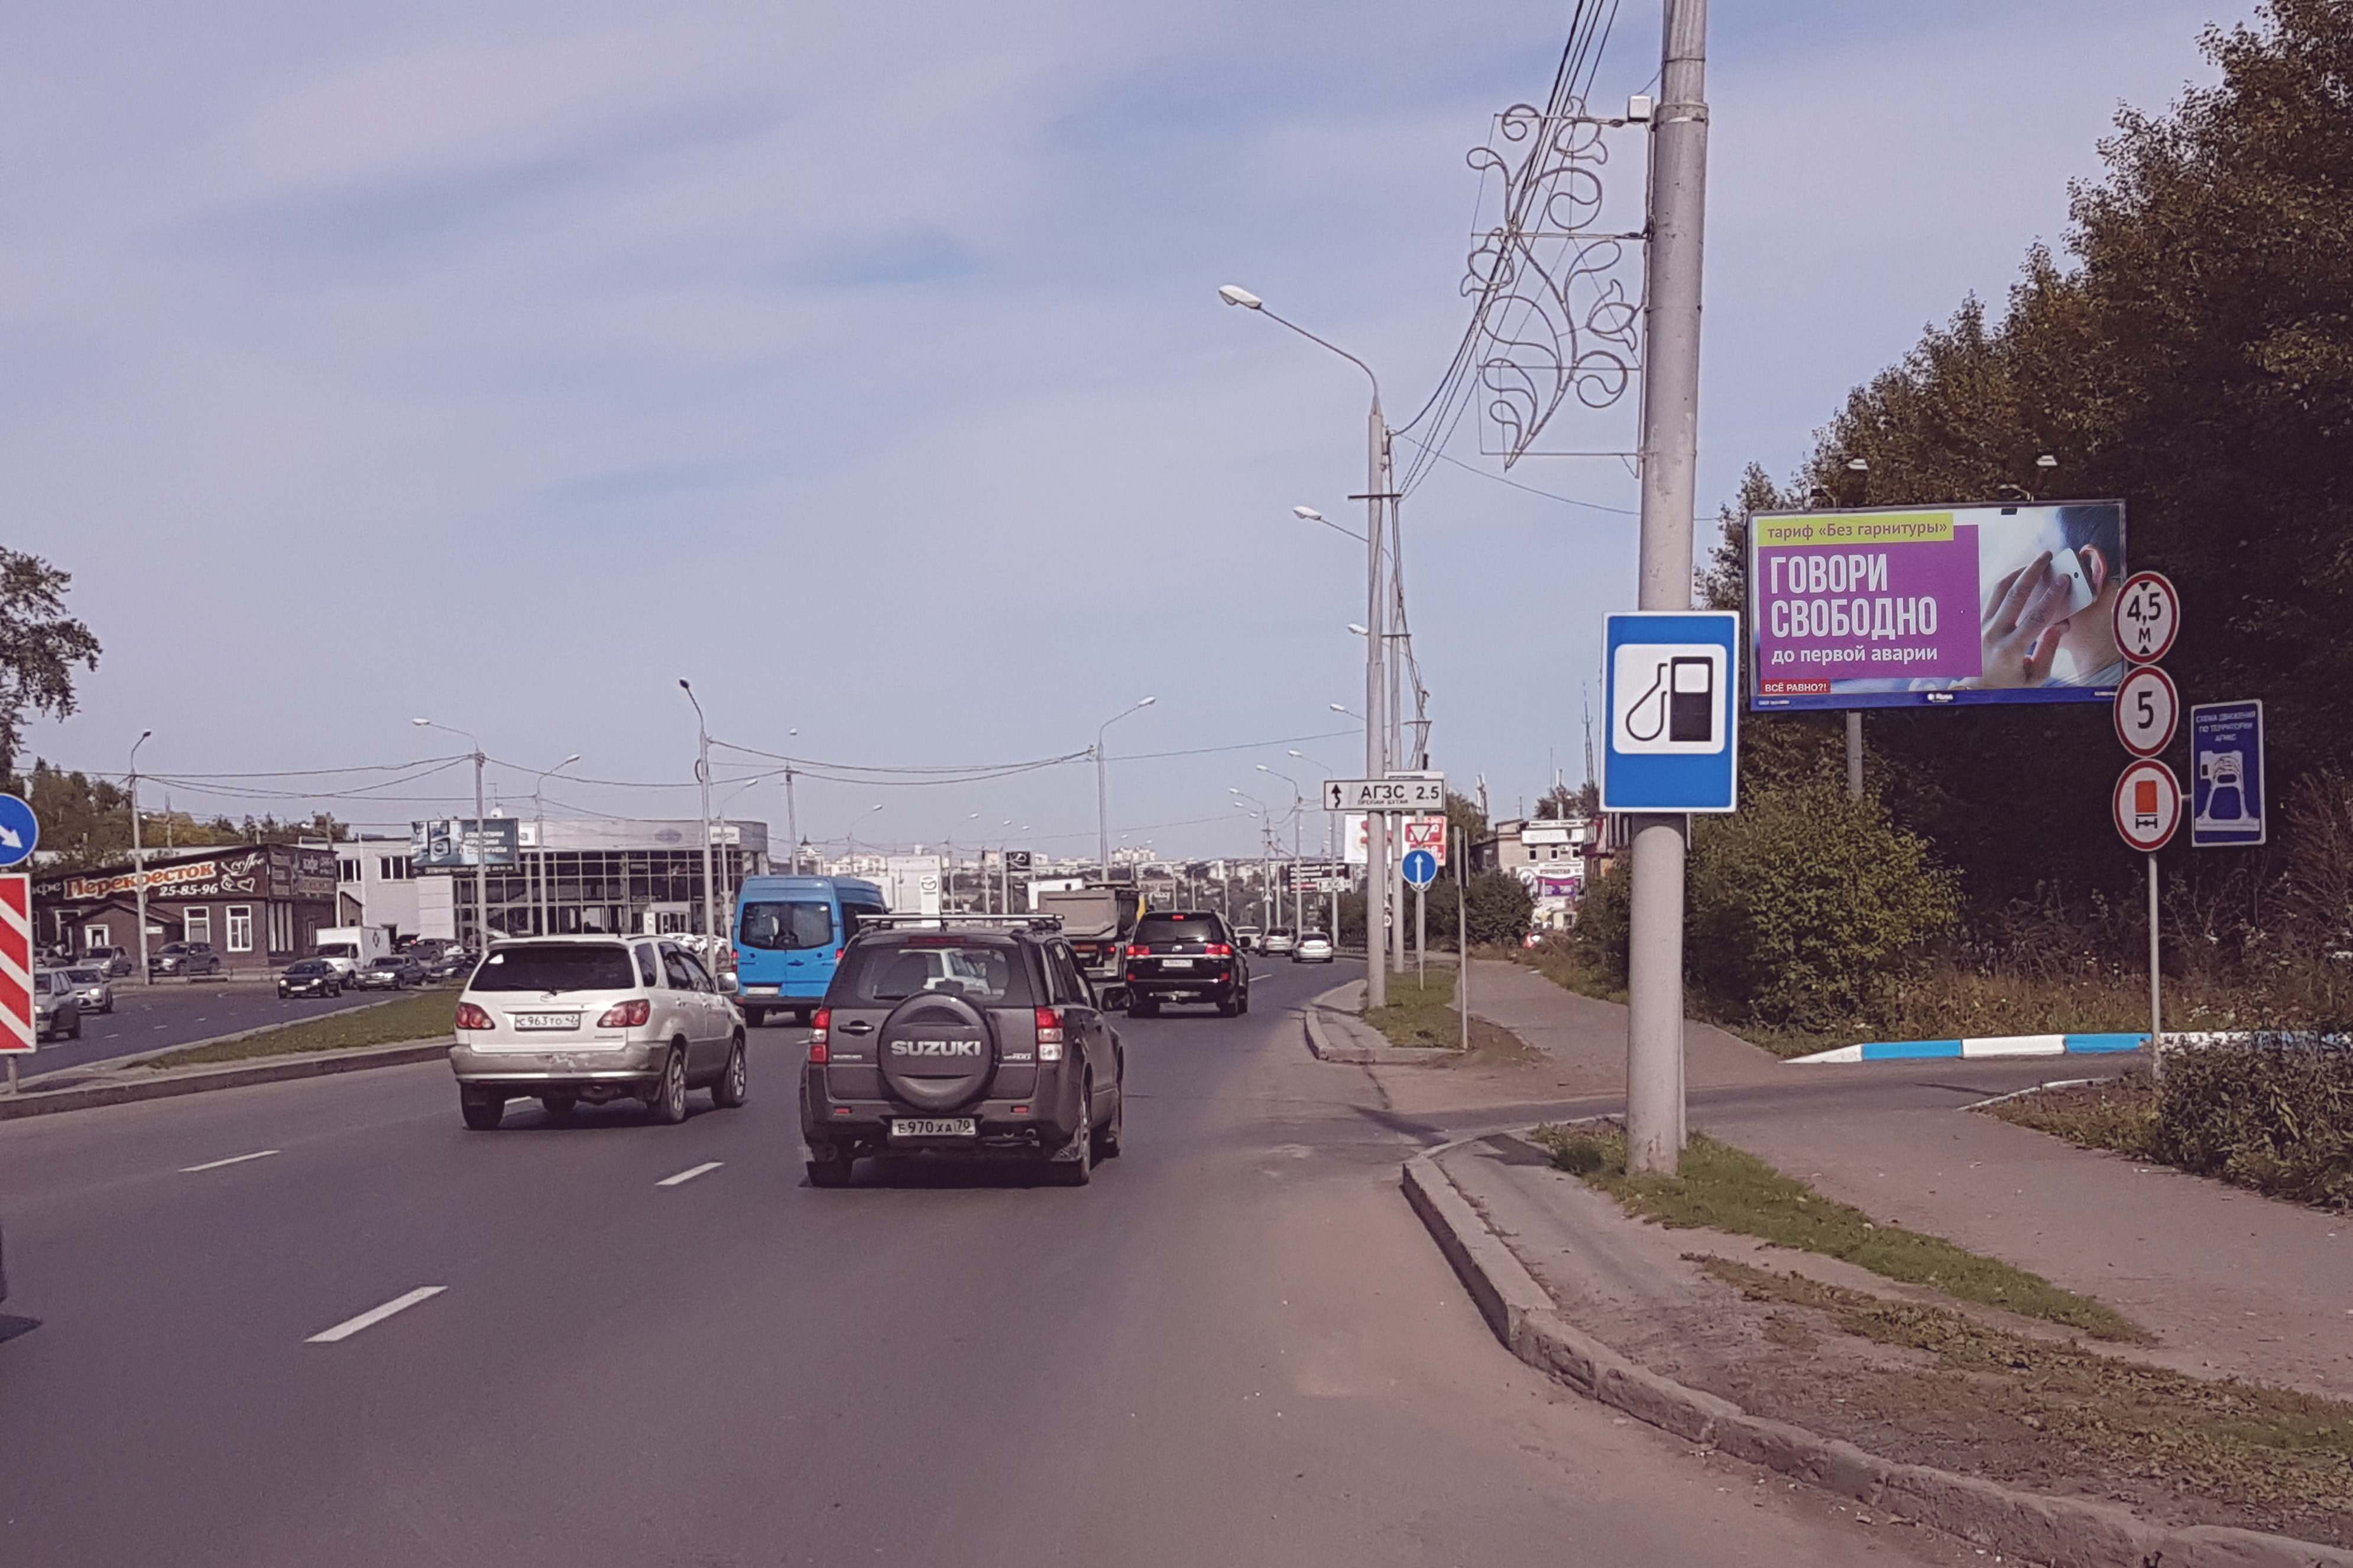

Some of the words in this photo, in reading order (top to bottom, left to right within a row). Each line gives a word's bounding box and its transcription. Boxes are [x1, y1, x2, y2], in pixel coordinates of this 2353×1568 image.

[1768, 525, 1813, 540] тариф
[1819, 523, 1852, 537] «Без
[1858, 522, 1947, 538] гарнитуры»
[1771, 554, 1888, 594] ГОВОРИ
[2127, 592, 2161, 626] 4,5
[1771, 596, 1937, 641] СВОБОДНО
[1771, 650, 1795, 665] до
[1801, 645, 1865, 665] первой
[1871, 648, 1937, 664] аварии
[1765, 682, 1784, 692] ВСЁ
[1787, 683, 1826, 692] РАВНО?!
[2137, 691, 2154, 729] 5
[1360, 785, 1405, 799] АГЗС
[1416, 786, 1440, 800] 2.5
[32, 881, 61, 895] фе
[159, 883, 219, 897] 25-85-96
[891, 1041, 981, 1056] SUZUKI
